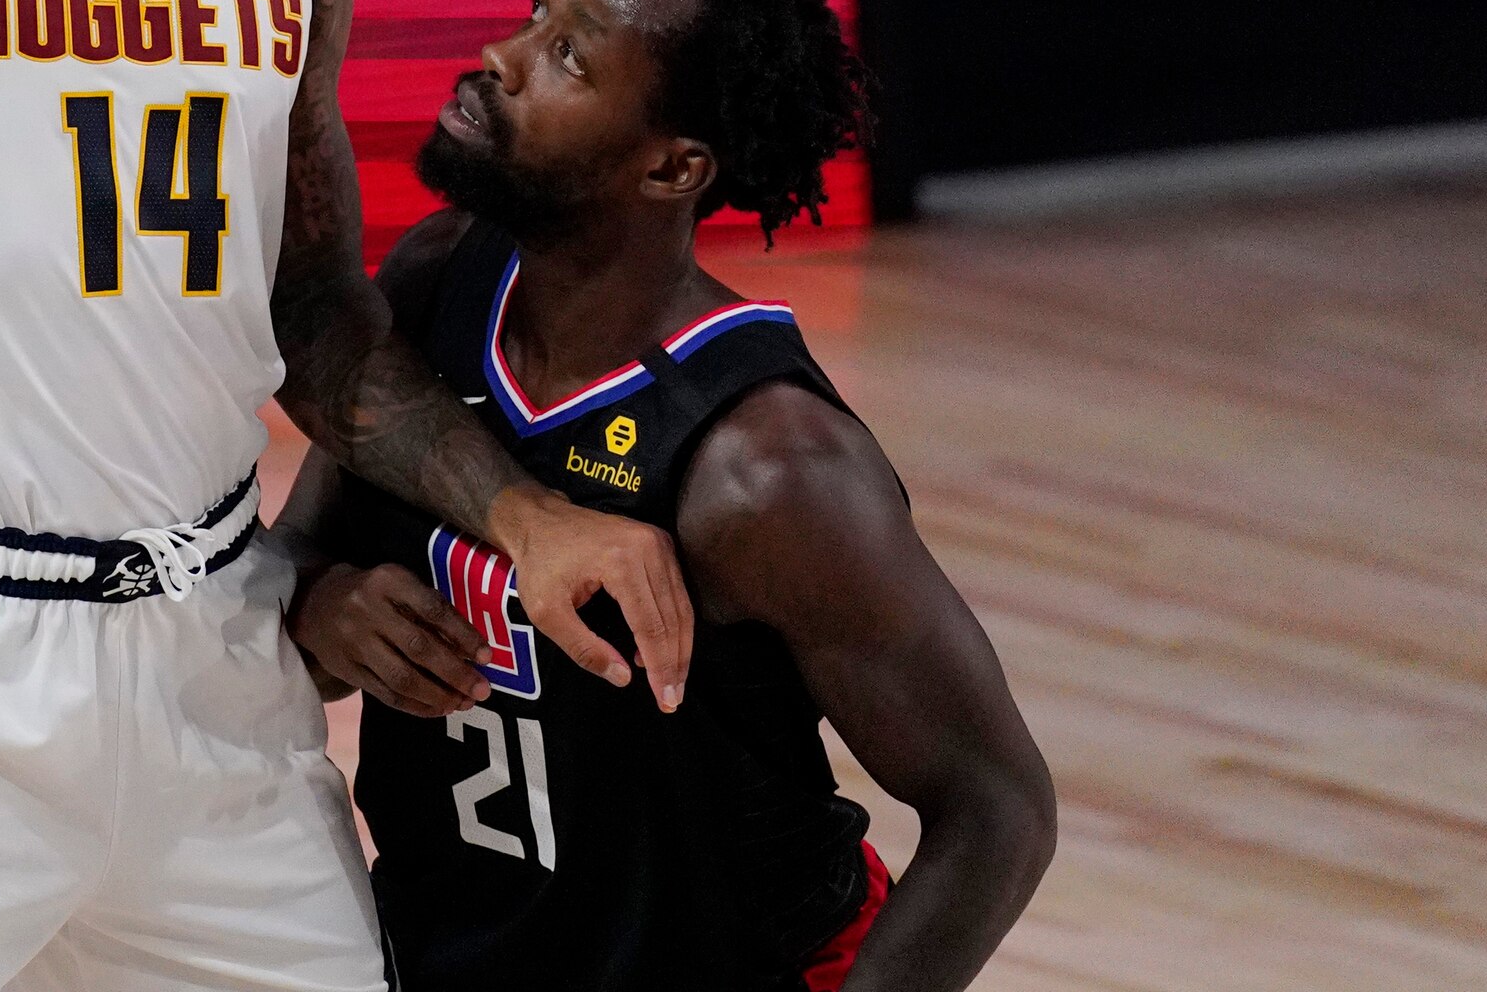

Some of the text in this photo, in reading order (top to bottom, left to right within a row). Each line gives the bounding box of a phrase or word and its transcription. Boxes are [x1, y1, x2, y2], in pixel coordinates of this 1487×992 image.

[61, 91, 229, 298] 14
[566, 446, 641, 492] bumble
[446, 706, 556, 872] 21
